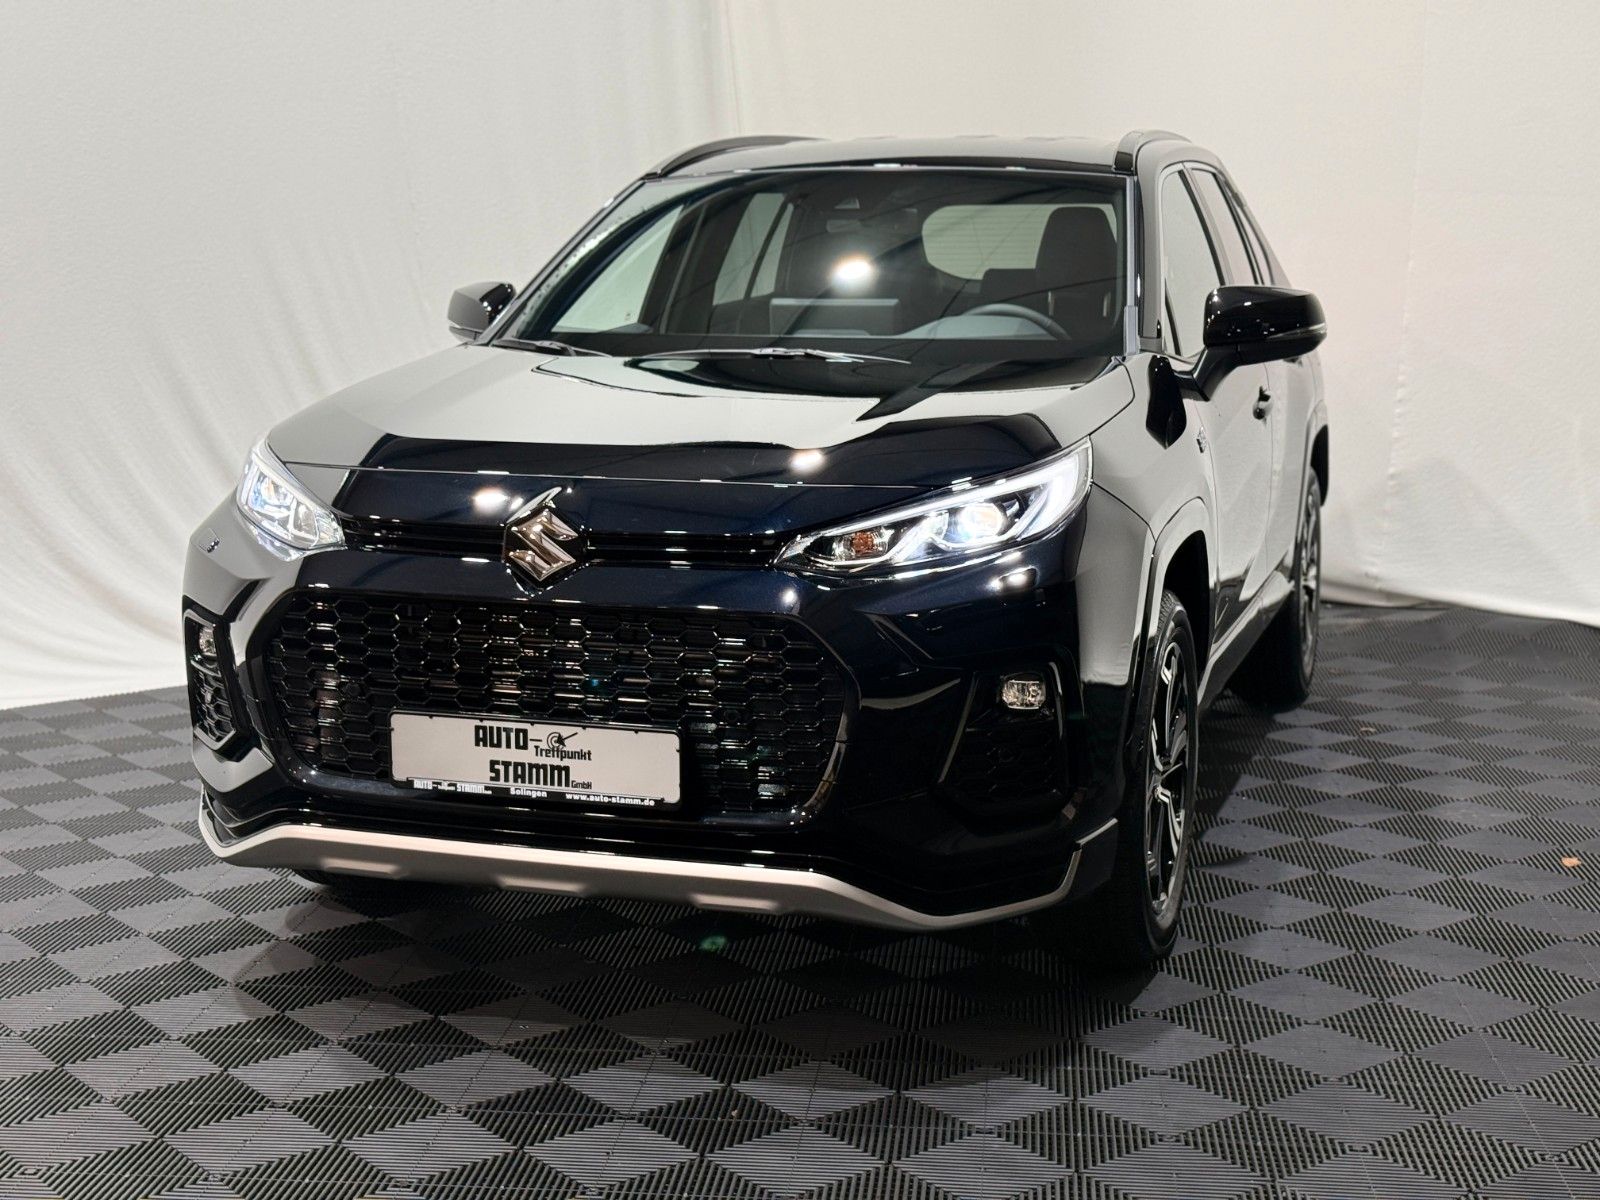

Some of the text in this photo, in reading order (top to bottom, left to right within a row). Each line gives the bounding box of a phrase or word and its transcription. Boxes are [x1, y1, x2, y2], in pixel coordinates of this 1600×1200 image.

[534, 745, 592, 761] Treffpunkt
[489, 759, 592, 790] STAMM GmbH
[510, 787, 547, 798] Solingen
[565, 792, 655, 807] www.auto-stamm.de
